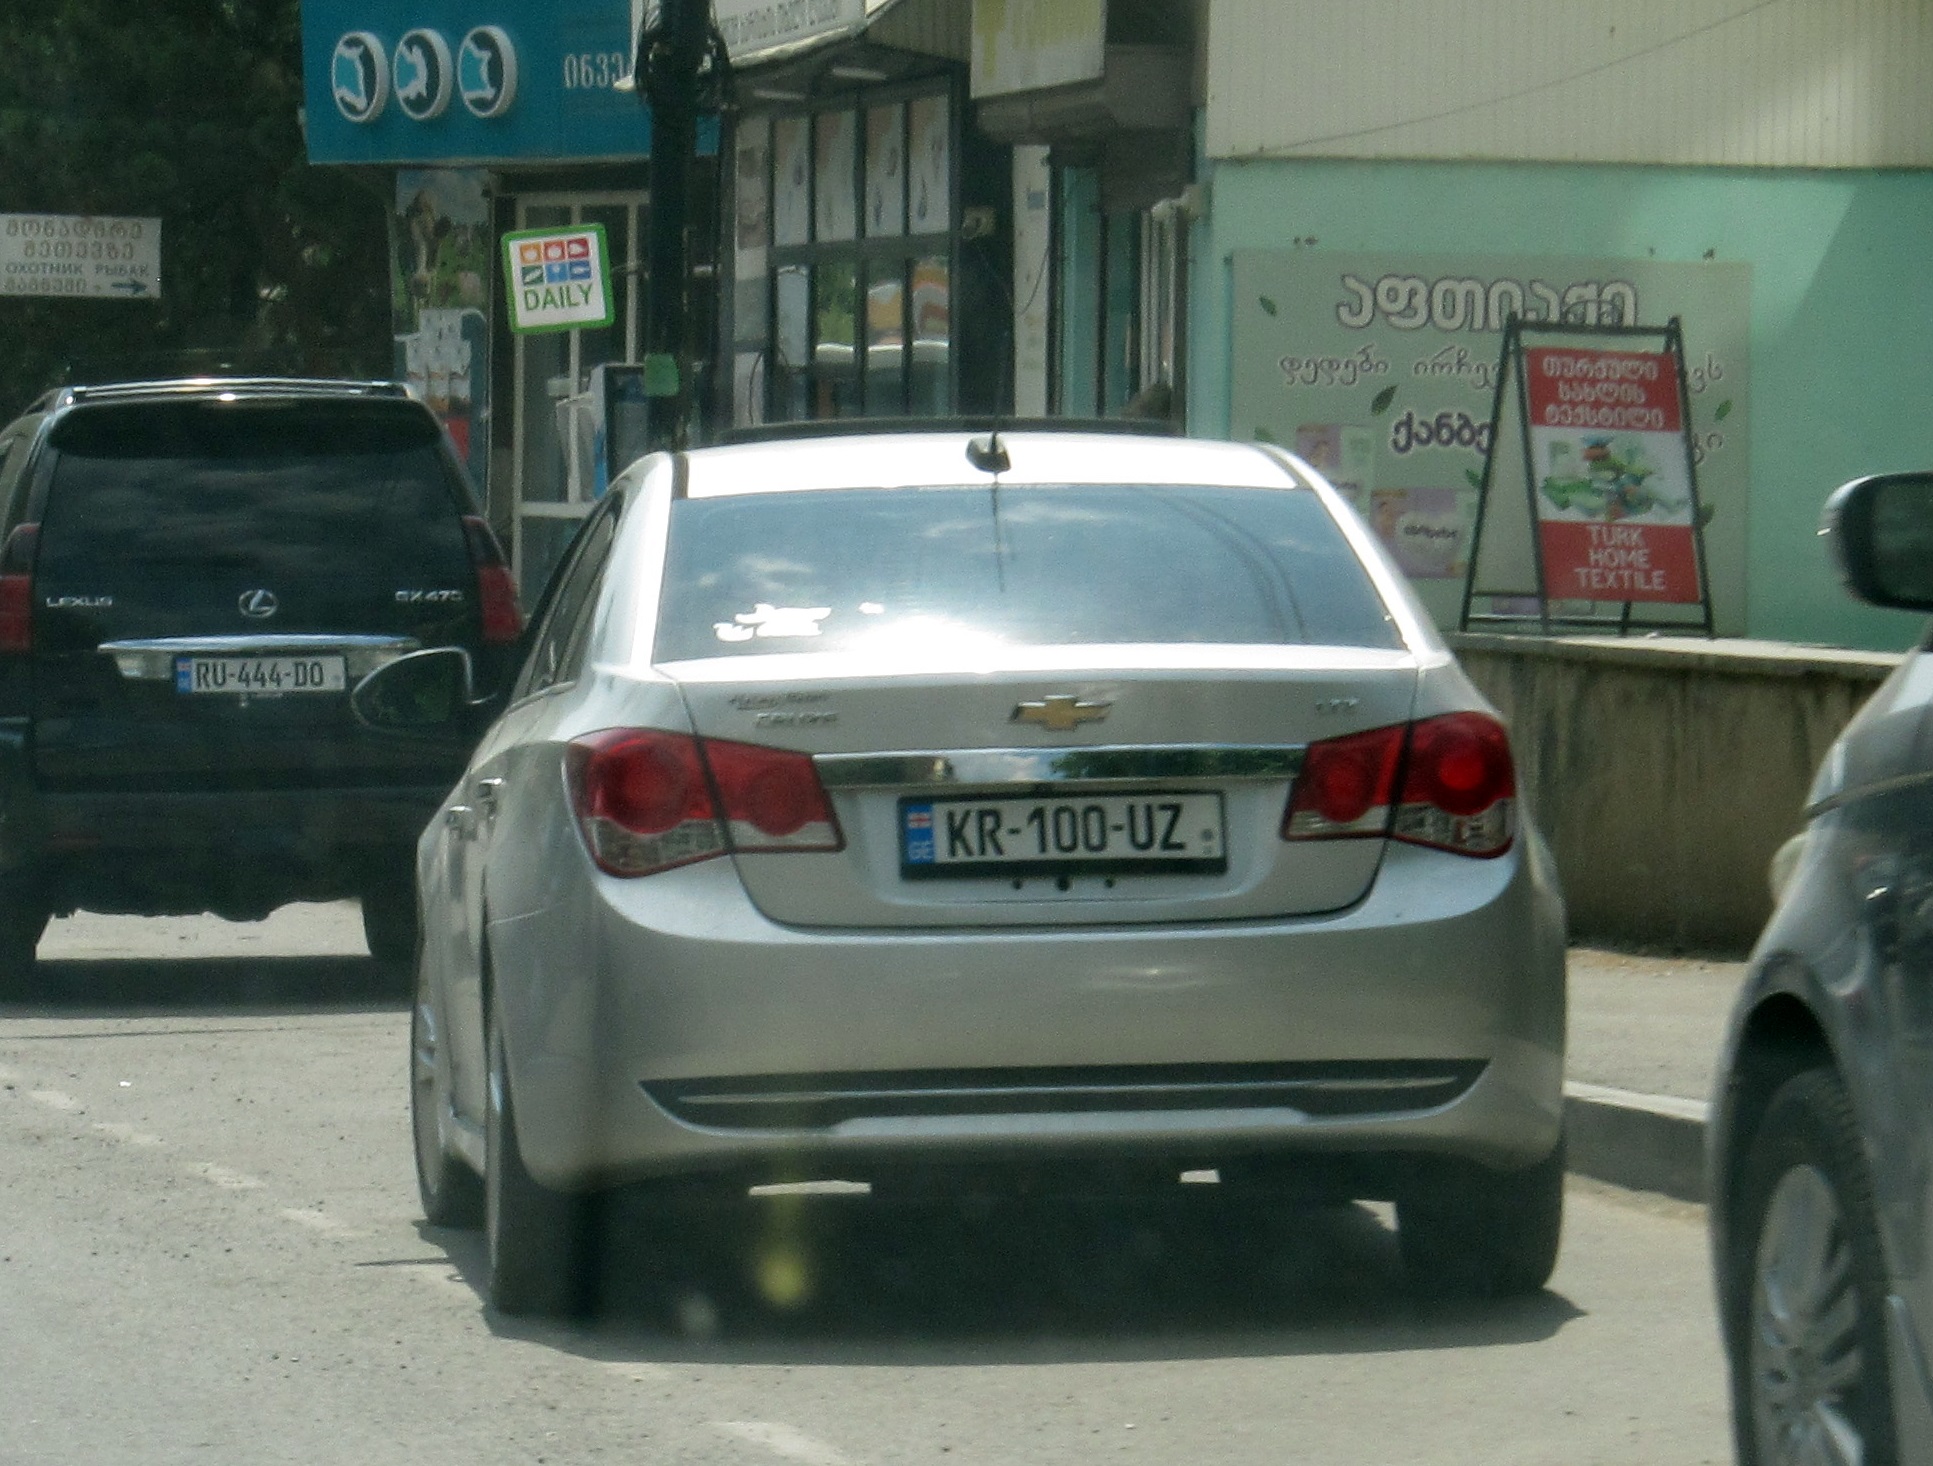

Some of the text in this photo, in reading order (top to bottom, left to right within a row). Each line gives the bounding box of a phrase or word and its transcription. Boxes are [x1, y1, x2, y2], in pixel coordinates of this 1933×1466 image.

[523, 282, 594, 312] DAILY
[1557, 379, 1647, 405] სახლის
[1588, 547, 1652, 570] HOME
[1573, 567, 1667, 592] TEXTILE
[45, 596, 113, 608] LEXUS
[195, 660, 324, 690] RU-444-DO
[945, 803, 1186, 858] KR-100-UZ
